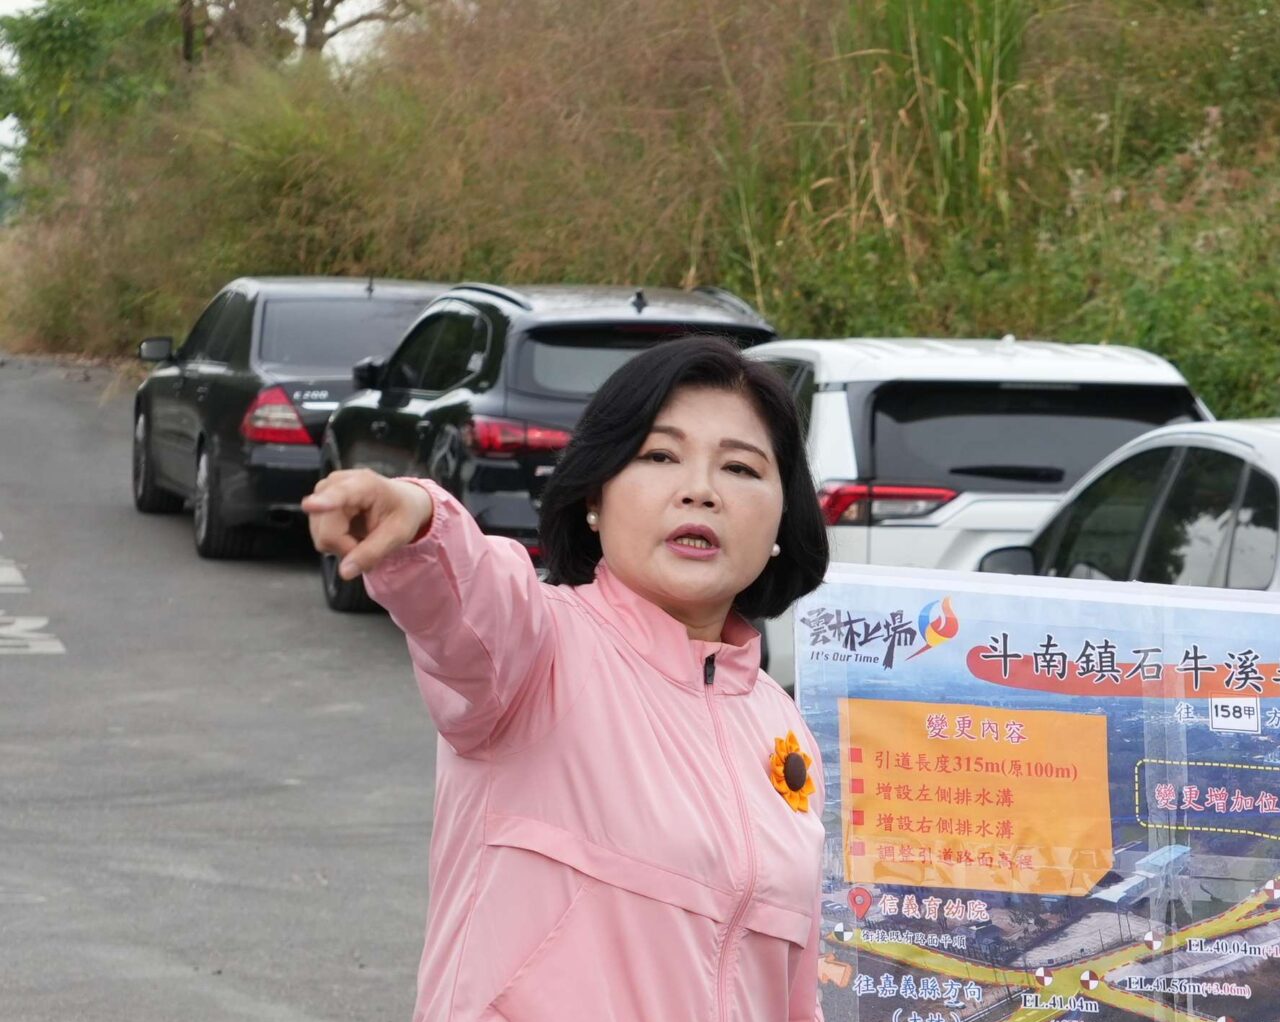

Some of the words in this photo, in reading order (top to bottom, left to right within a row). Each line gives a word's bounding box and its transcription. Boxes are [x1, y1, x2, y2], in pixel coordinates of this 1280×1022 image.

[811, 651, 829, 661] It's
[832, 652, 852, 662] Our
[854, 653, 879, 664] Time
[1175, 702, 1196, 721] 往
[1212, 704, 1257, 720] 158甲
[925, 713, 1029, 744] 變更內容
[875, 750, 1078, 781] 引道長度315m(原100m)
[875, 782, 1014, 807] 增設左側排水溝
[875, 813, 1015, 839] 增設右側排水溝
[876, 844, 1034, 870] 調整引道路面高程
[879, 894, 989, 921] 信義育幼院
[854, 974, 982, 1002] 往嘉義縣方向
[1021, 993, 1099, 1013] EL.41.04m
